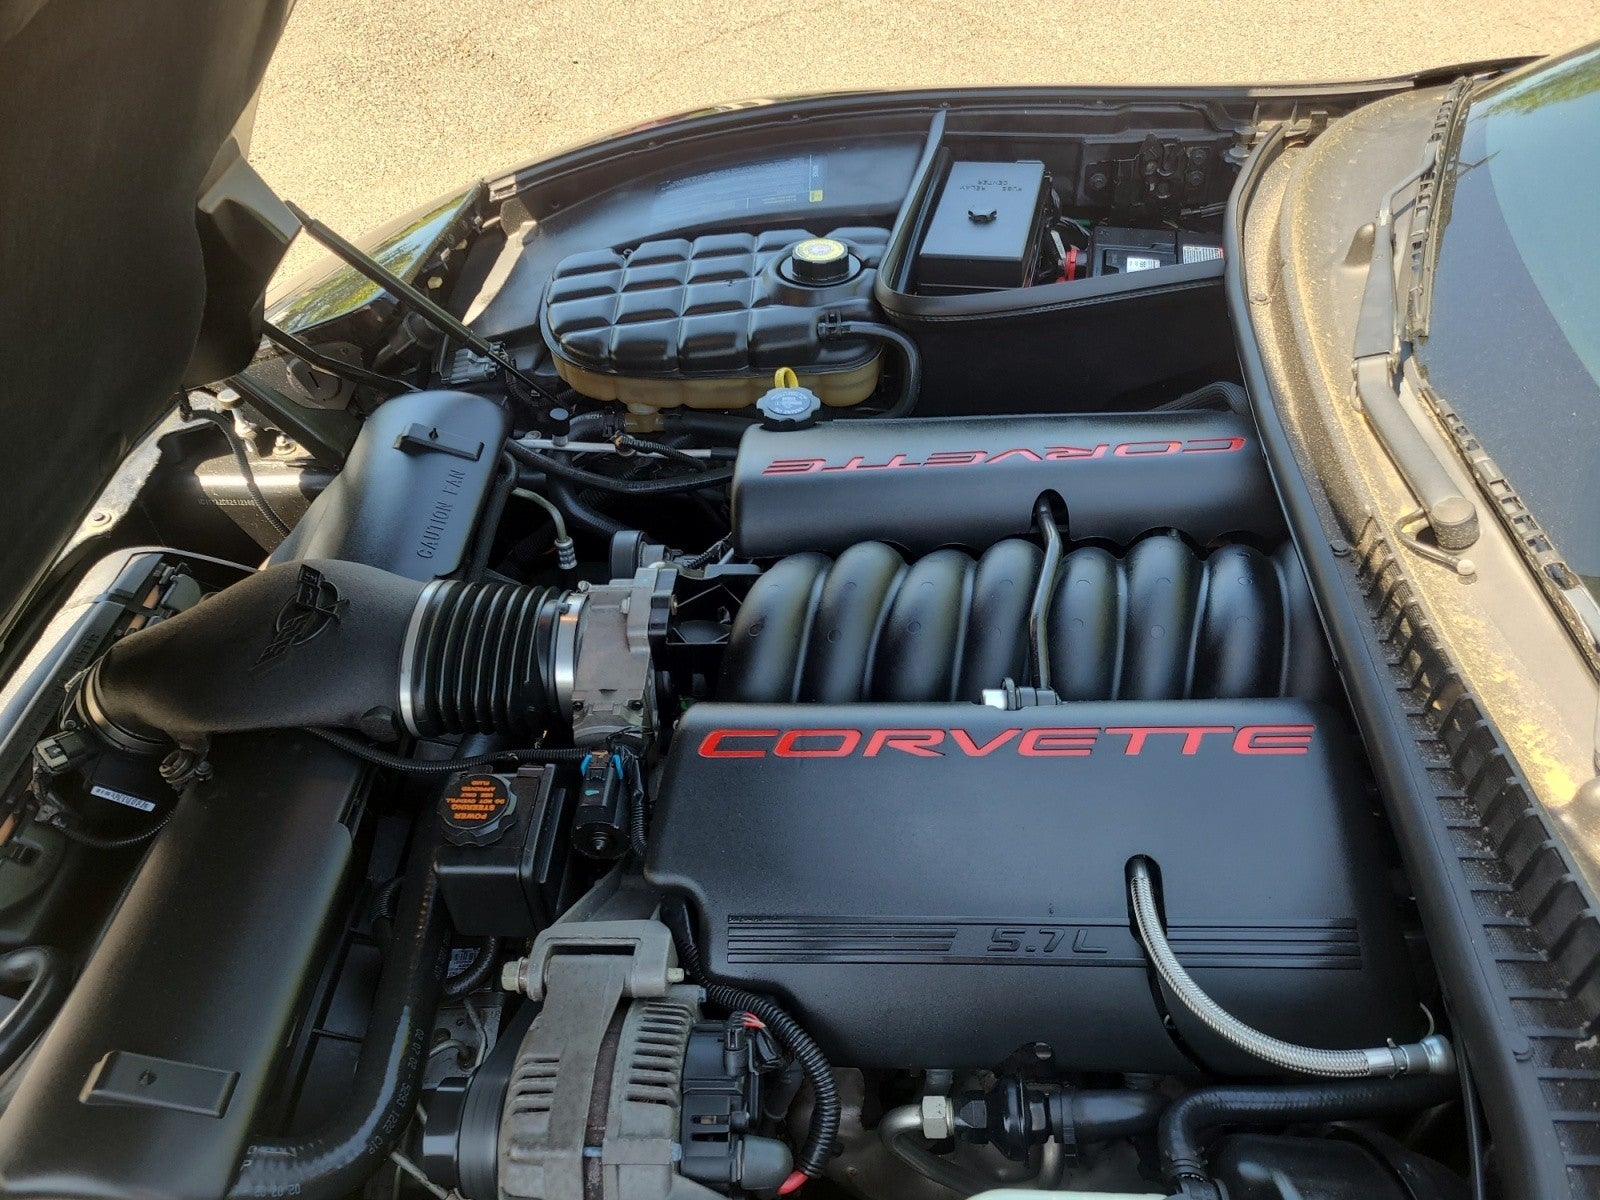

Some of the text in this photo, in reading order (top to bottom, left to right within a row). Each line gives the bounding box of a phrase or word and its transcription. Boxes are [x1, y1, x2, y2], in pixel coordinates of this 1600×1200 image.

[762, 437, 1246, 476] CORVETTE
[416, 469, 466, 559] CAUTION FAN
[698, 724, 1316, 759] CORVETTE
[453, 812, 488, 820] POWER
[986, 927, 1108, 954] 5.7L
